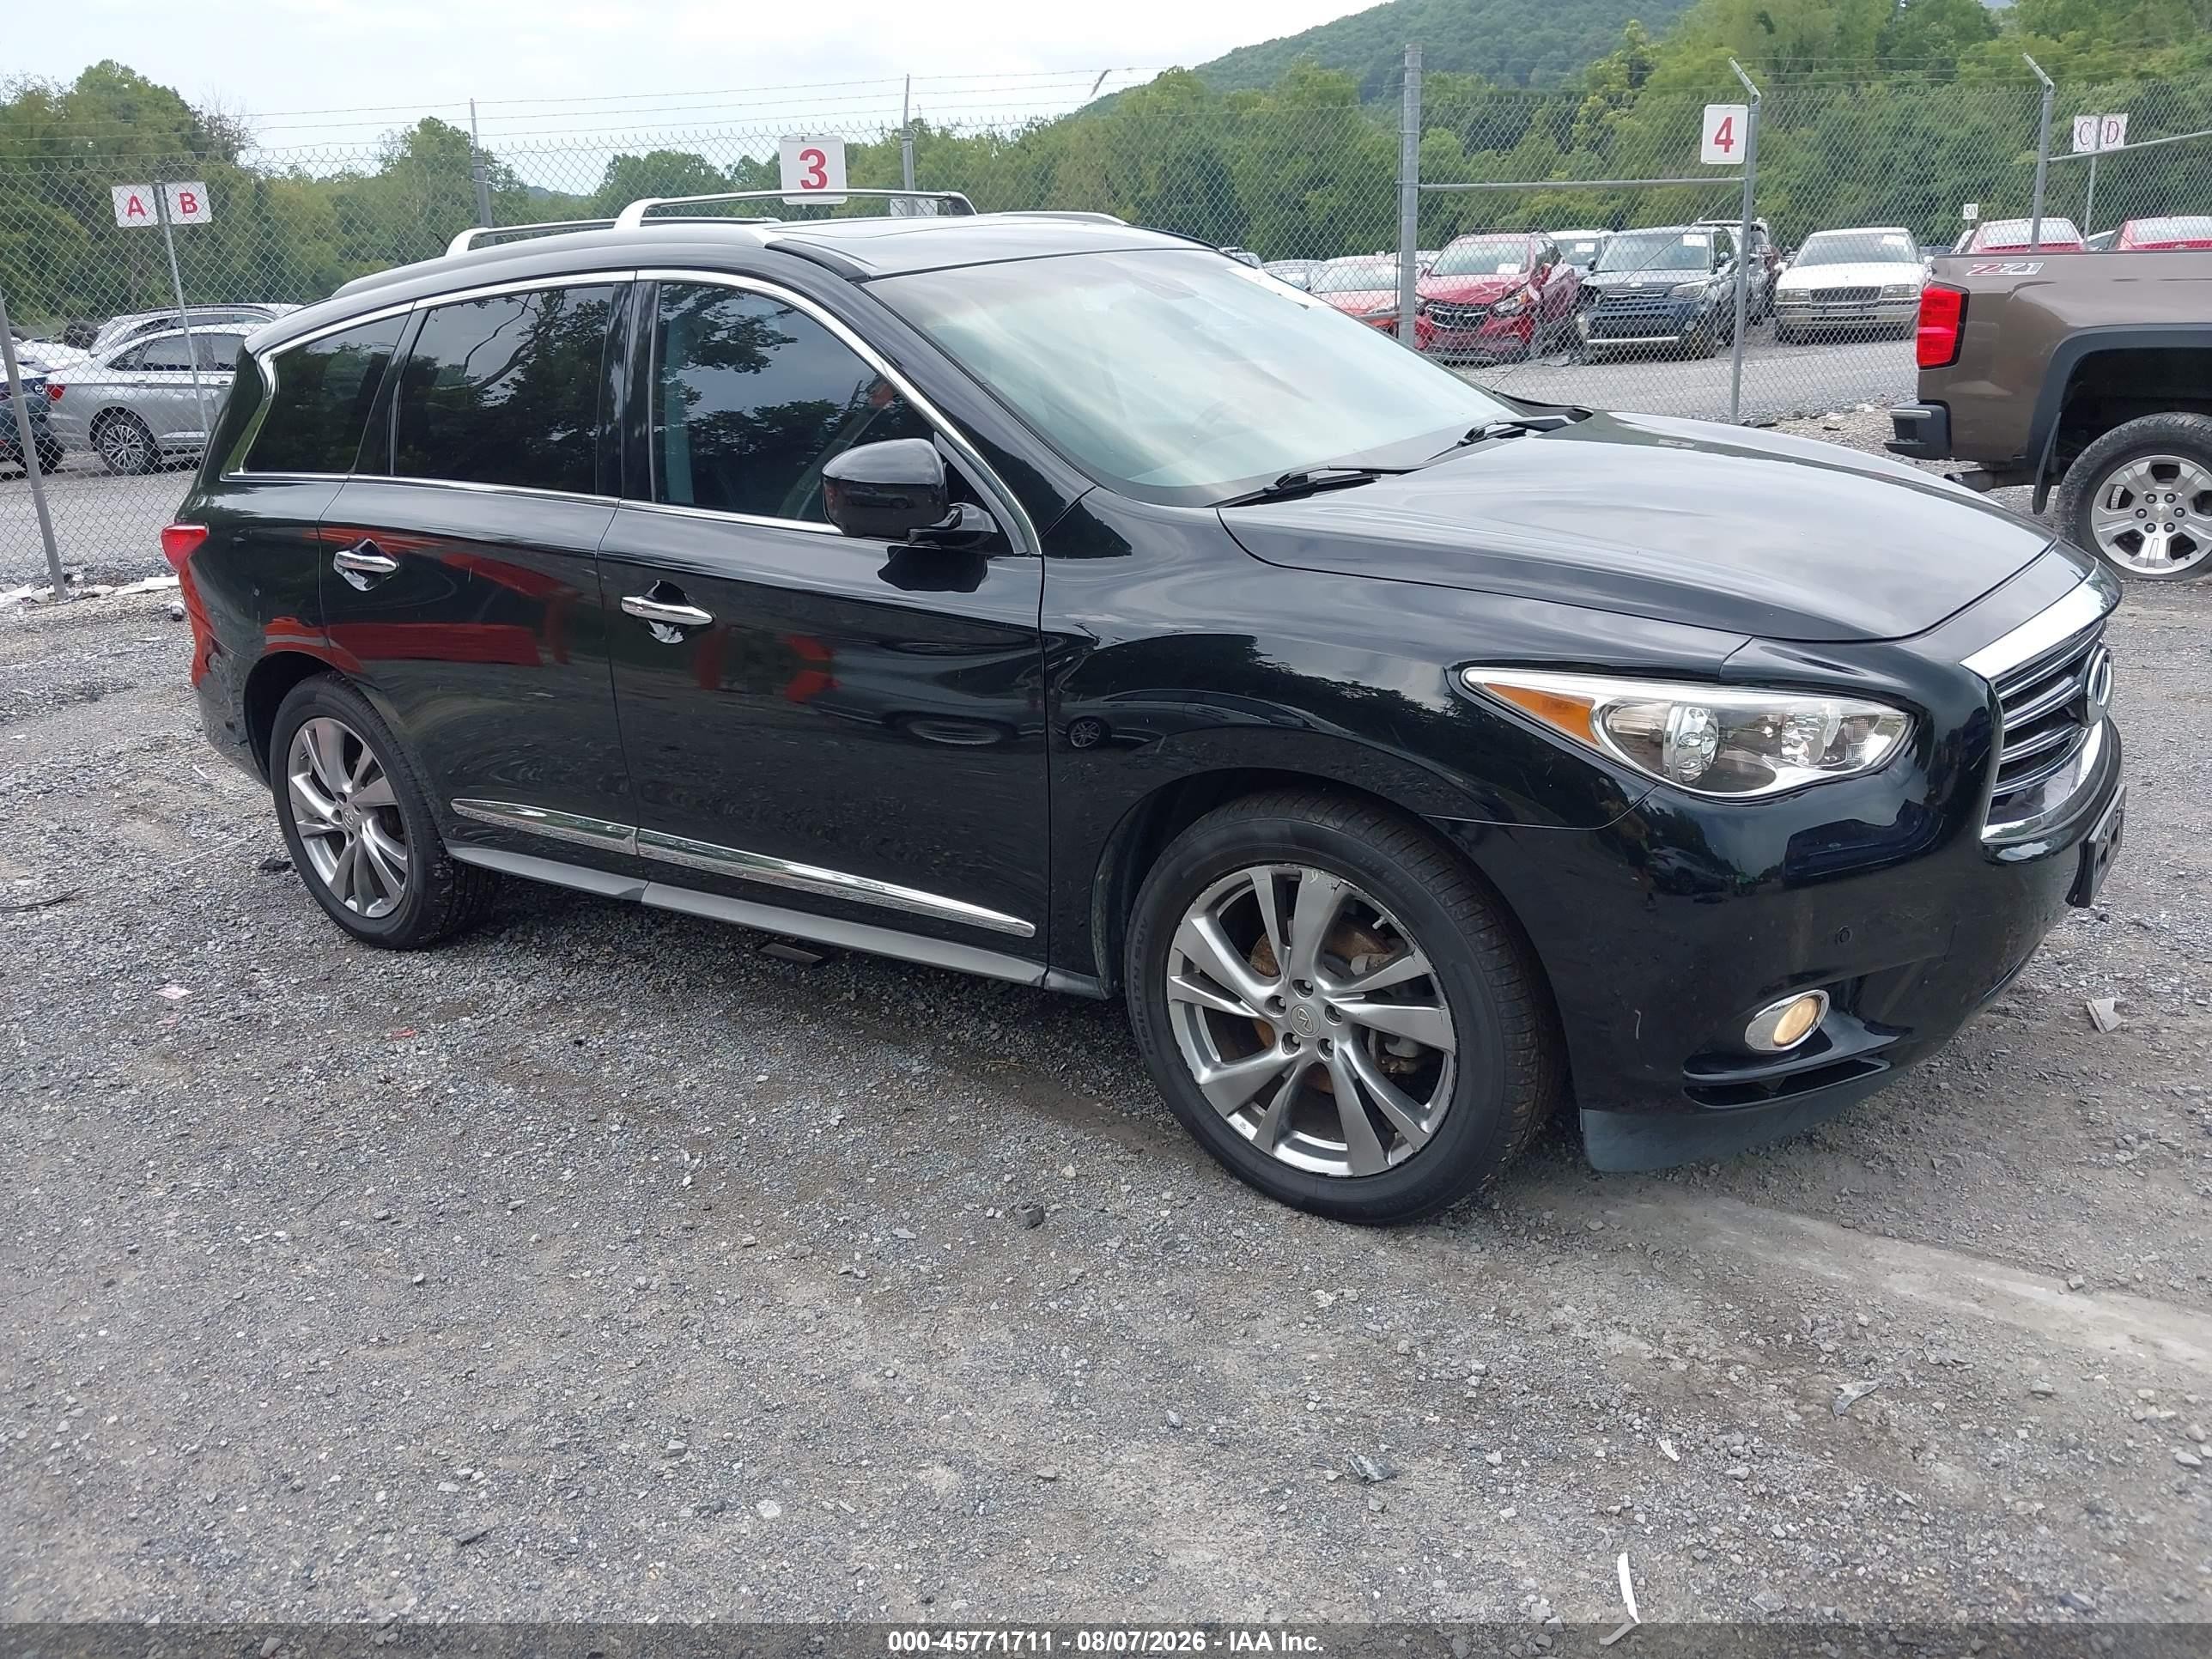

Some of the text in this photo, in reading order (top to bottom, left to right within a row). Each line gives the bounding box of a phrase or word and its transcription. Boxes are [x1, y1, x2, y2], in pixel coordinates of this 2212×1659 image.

[1714, 116, 1734, 153] 4
[2079, 122, 2092, 145] C
[2105, 121, 2119, 144] D
[799, 149, 828, 190] 3
[126, 194, 147, 218] A
[179, 192, 198, 215] B
[1965, 262, 2045, 276] Z71
